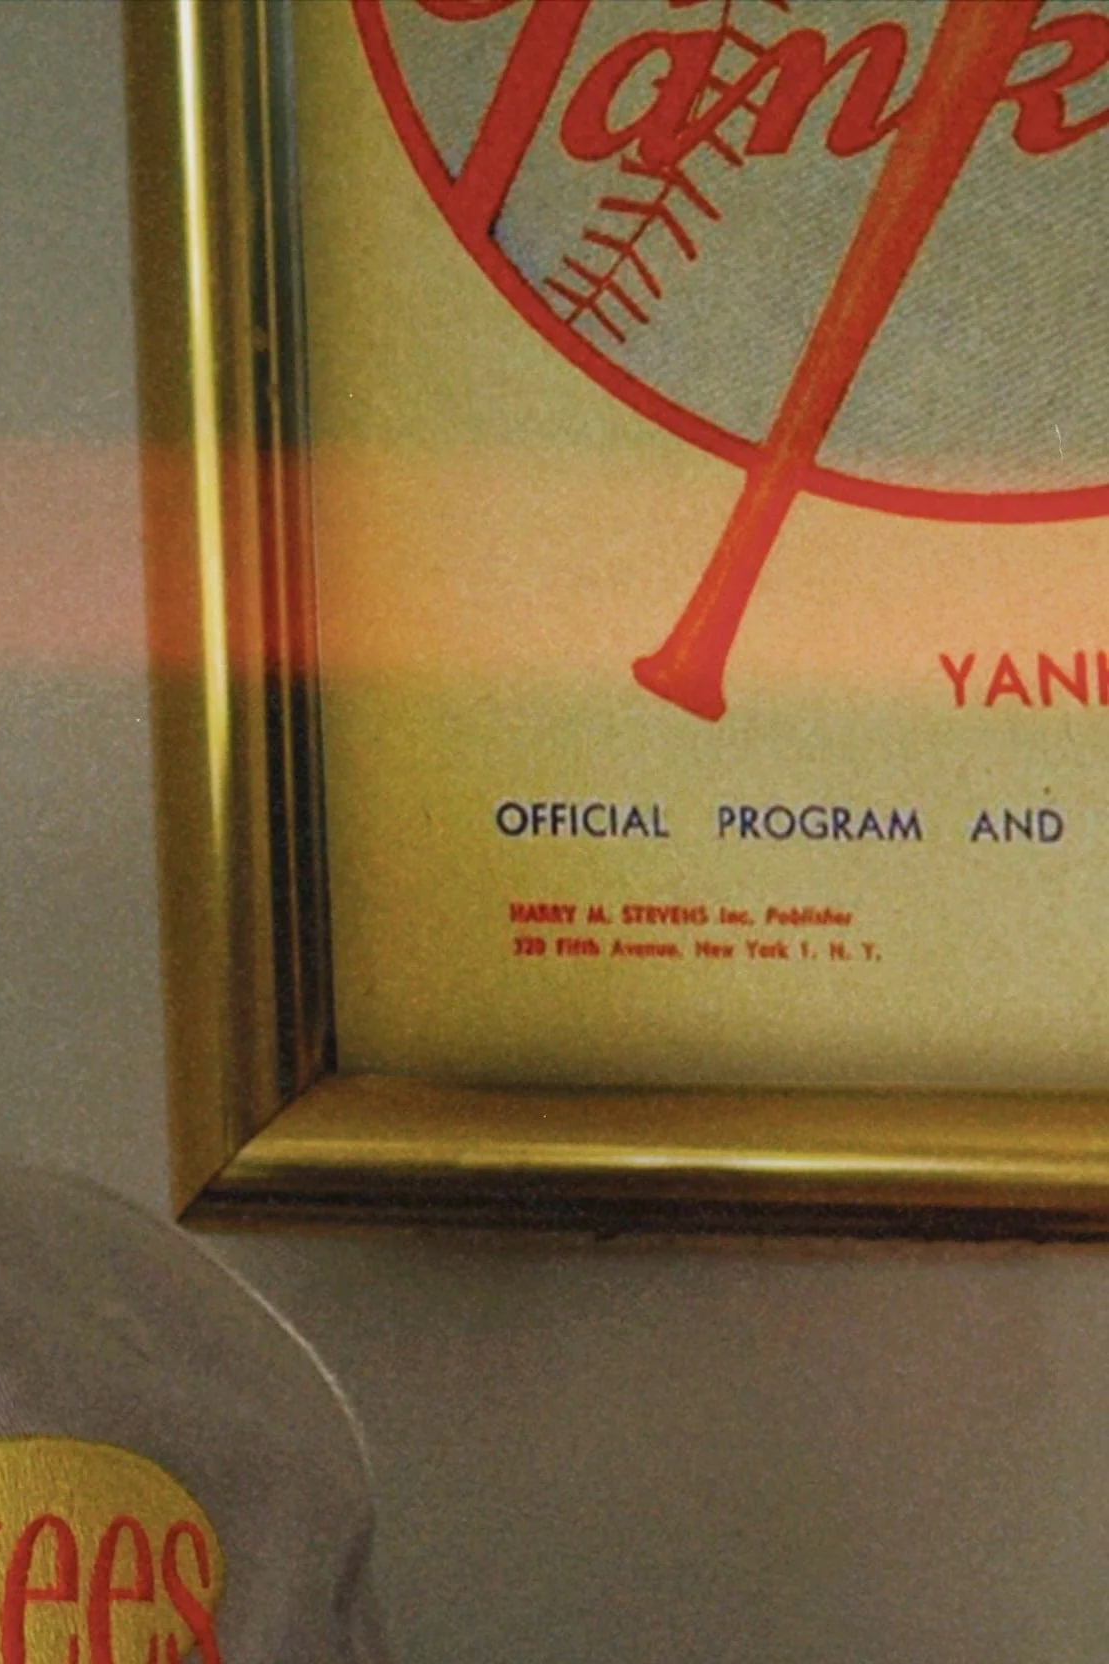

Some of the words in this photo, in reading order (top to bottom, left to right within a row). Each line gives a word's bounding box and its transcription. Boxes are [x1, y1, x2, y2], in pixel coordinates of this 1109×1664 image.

[495, 802, 669, 838] OFFICIAL
[718, 805, 922, 842] PROGRAM
[970, 807, 1064, 844] AND
[510, 903, 577, 924] HARRY
[621, 905, 709, 925] STEVENS
[695, 940, 734, 958] New
[746, 940, 789, 959] York
